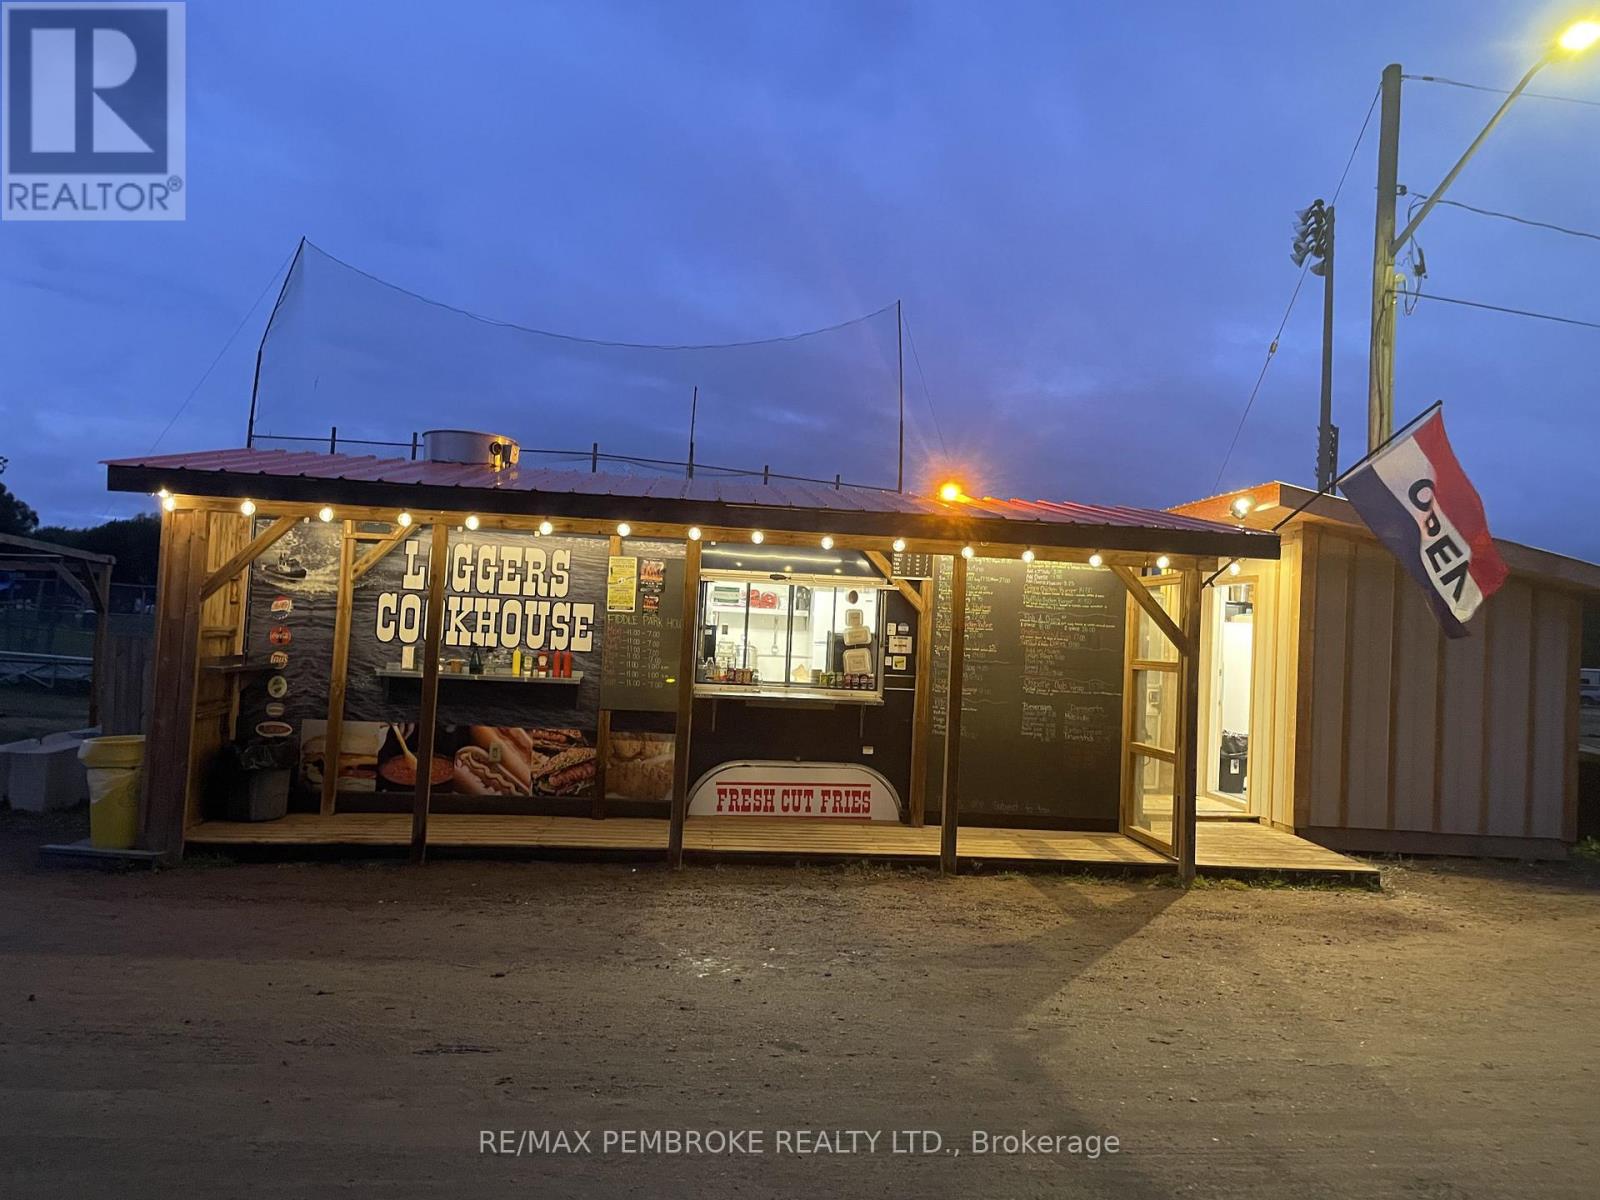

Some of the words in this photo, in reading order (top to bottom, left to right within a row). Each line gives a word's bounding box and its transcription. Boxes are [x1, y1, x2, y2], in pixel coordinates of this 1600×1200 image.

[716, 788, 775, 812] FRESH
[781, 789, 814, 813] CUT
[820, 790, 871, 814] FRIES
